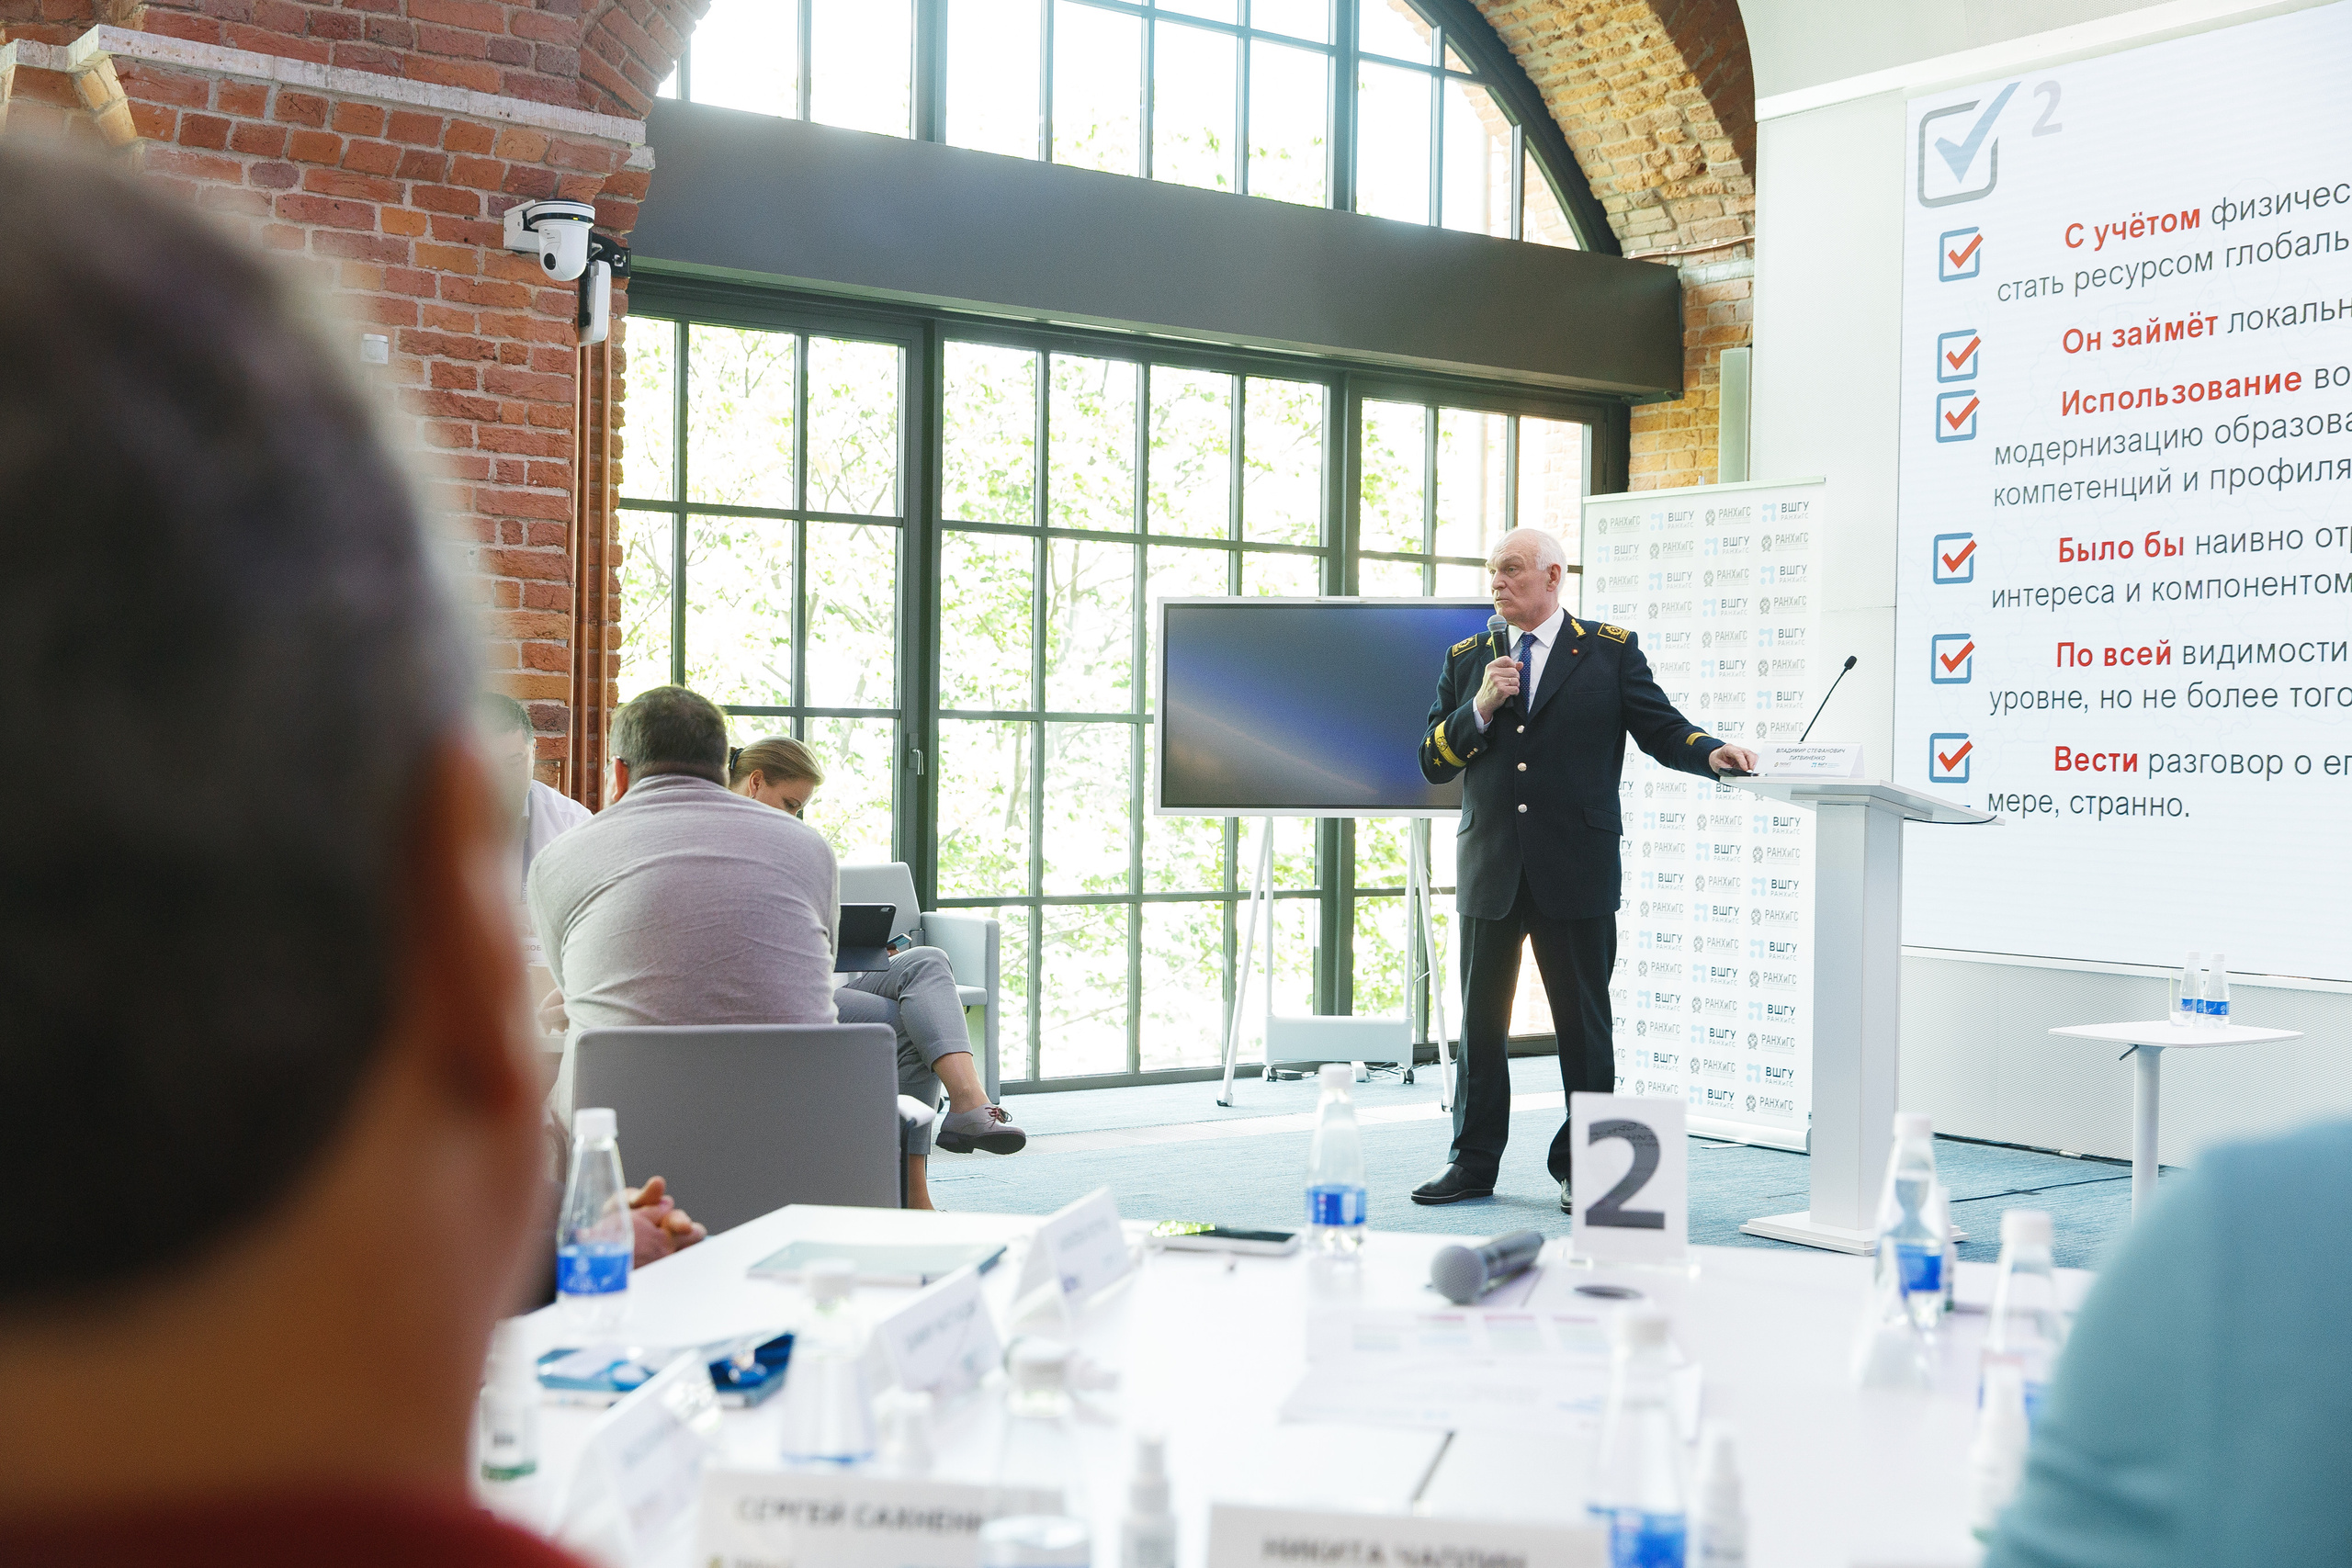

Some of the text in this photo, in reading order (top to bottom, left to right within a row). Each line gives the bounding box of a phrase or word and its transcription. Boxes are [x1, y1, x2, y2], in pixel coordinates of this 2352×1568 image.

[2032, 80, 2063, 137] 2
[2065, 184, 2350, 251] С учётом физичес
[1997, 231, 2349, 301] стать ресурсом глобаль
[2064, 298, 2352, 354] Он займёт локальн
[2062, 367, 2350, 416] Использование во
[1996, 427, 2202, 468] модернизацию
[1995, 457, 2351, 506] компетенций и профиля
[1719, 507, 1751, 517] РАНХиГС
[1781, 502, 1809, 513] ВШГУ
[1610, 515, 1640, 526] РАНХиГС
[1668, 511, 1694, 522] ВШГУ
[1724, 536, 1749, 547] ВШГУ
[1775, 533, 1808, 544] РАНХиГС
[2059, 525, 2352, 563] Было бы наивно от
[1615, 544, 1639, 555] ВШГУ
[1663, 540, 1693, 551] РАНХиГС
[1717, 569, 1749, 580] РАНХиГС
[1780, 564, 1807, 576] ВШГУ
[1610, 575, 1638, 585] РАНХиГС
[1667, 571, 1692, 581] ВШГУ
[1993, 571, 2352, 610] интереса и компонентом
[1722, 599, 1747, 608] ВШГУ
[1773, 595, 1806, 606] РАНХиГС
[1613, 604, 1637, 614] ВШГУ
[1661, 601, 1692, 612] РАНХиГС
[1666, 632, 1690, 642] ВШГУ
[1715, 630, 1747, 641] РАНХиГС
[1779, 628, 1805, 638] ВШГУ
[2057, 639, 2347, 670] По всей видимости
[1660, 661, 1690, 672] РАНХиГС
[1720, 660, 1747, 670] ВШГУ
[1772, 660, 1804, 670] РАНХиГС
[1713, 693, 1746, 703] РАНХиГС
[1777, 691, 1804, 701] ВШГУ
[1990, 682, 2352, 715] уровне, но не более того
[1718, 721, 1745, 731] ВШГУ
[1770, 722, 1804, 732] РАНХиГС
[2055, 746, 2138, 772] Вести
[2149, 752, 2283, 781] разговор
[2294, 754, 2312, 775] о
[1619, 782, 1634, 790] ГУ
[1657, 783, 1687, 792] РАНХиГС
[1988, 792, 2189, 820] мере, странно.
[1660, 813, 1686, 822] ВШГУ
[1711, 815, 1742, 826] РАНХиГС
[1773, 817, 1801, 827] ВШГУ
[1622, 840, 1633, 850] ГУ
[1655, 842, 1686, 852] РАНХиГС
[1714, 844, 1741, 854] ВШГУ
[1767, 847, 1801, 858] РАНХиГС
[1658, 873, 1684, 883] ВШГУ
[1709, 876, 1741, 887] РАНХиГС
[1771, 879, 1799, 890] ВШГУ
[1653, 902, 1683, 913] РАНХиГС
[1713, 906, 1739, 917] ВШГУ
[1765, 909, 1799, 921] РАНХиГС
[1657, 932, 1682, 943] ВШГУ
[1707, 937, 1739, 949] РАНХиГС
[1770, 942, 1797, 953] ВШГУ
[1614, 958, 1628, 967] ГУ
[1651, 961, 1682, 974] РАНХиГС
[1712, 966, 1738, 977] ВШГУ
[1763, 972, 1797, 985] РАНХиГС
[1656, 993, 1680, 1003] ВШГУ
[1705, 998, 1737, 1010] РАНХиГС
[1768, 1004, 1795, 1016] ВШГУ
[1612, 1017, 1626, 1026] ГУ
[1650, 1021, 1680, 1034] РАНХиГС
[1709, 1028, 1736, 1039] ВШГУ
[1761, 1034, 1795, 1047] РАНХиГС
[1654, 1053, 1679, 1063] ВШГУ
[1703, 1059, 1736, 1072] РАНХиГС
[1766, 1066, 1794, 1078] ВШГУ
[1648, 1081, 1679, 1094] РАНХиГС
[1708, 1089, 1735, 1100] ВШГУ
[1760, 1097, 1793, 1111] РАНХиГС
[1586, 1119, 1665, 1229] 2
